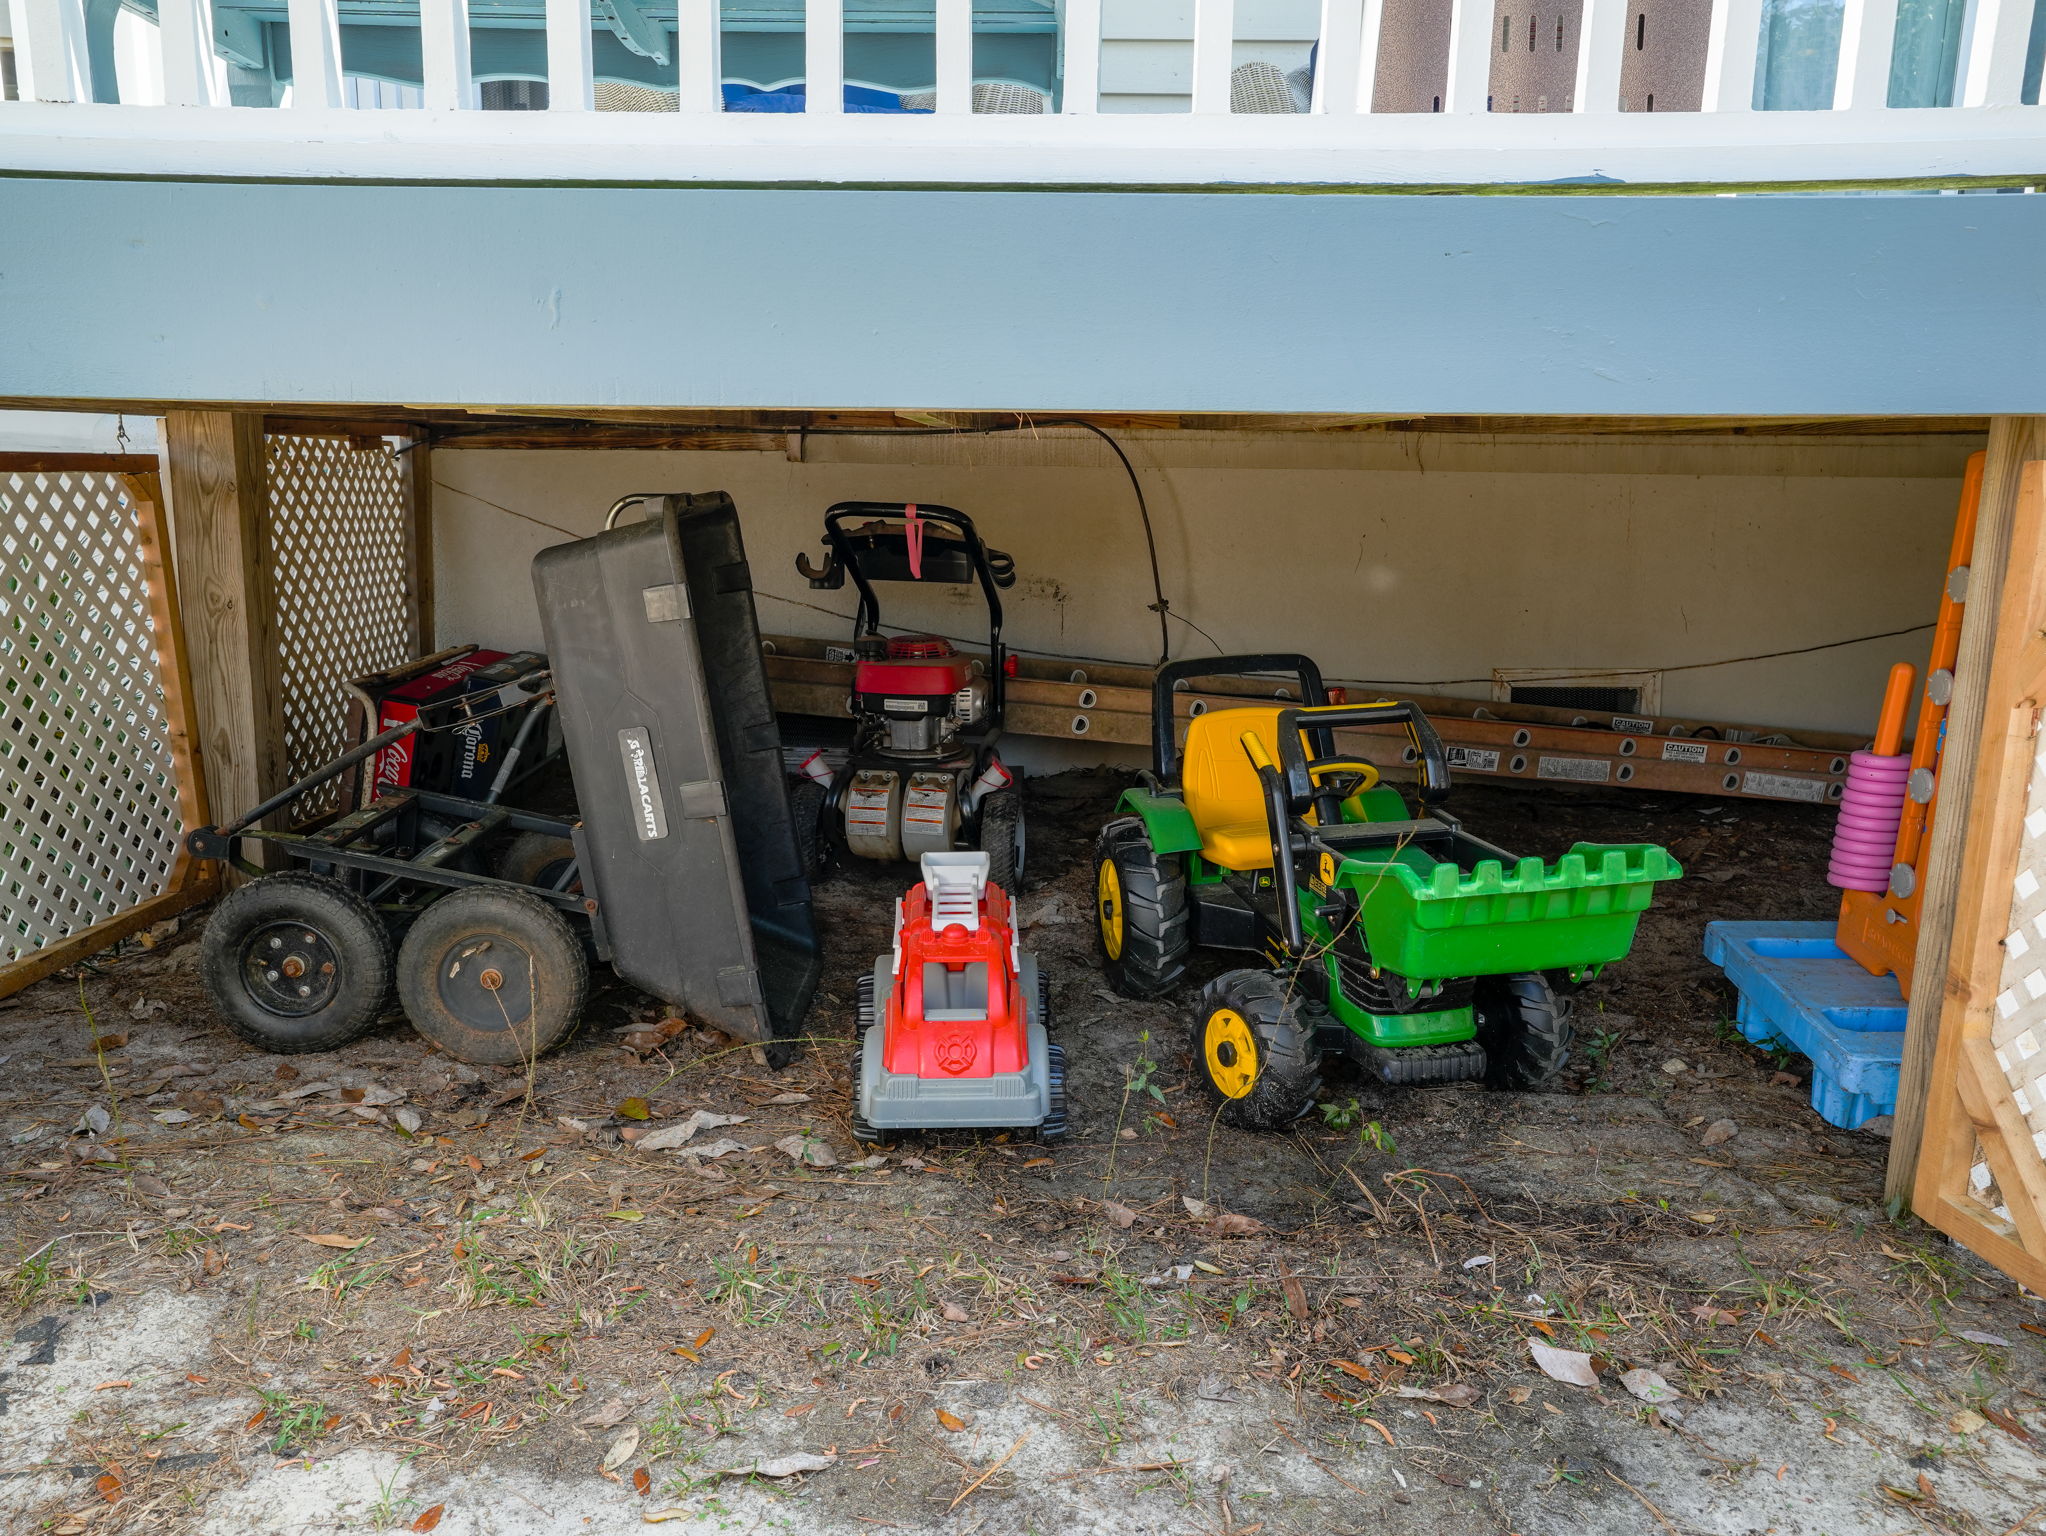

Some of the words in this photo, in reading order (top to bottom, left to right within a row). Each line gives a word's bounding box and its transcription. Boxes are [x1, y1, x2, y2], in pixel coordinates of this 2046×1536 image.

[1615, 719, 1650, 729] CAUTION
[461, 722, 483, 779] Corona
[1667, 744, 1704, 753] CAUTION
